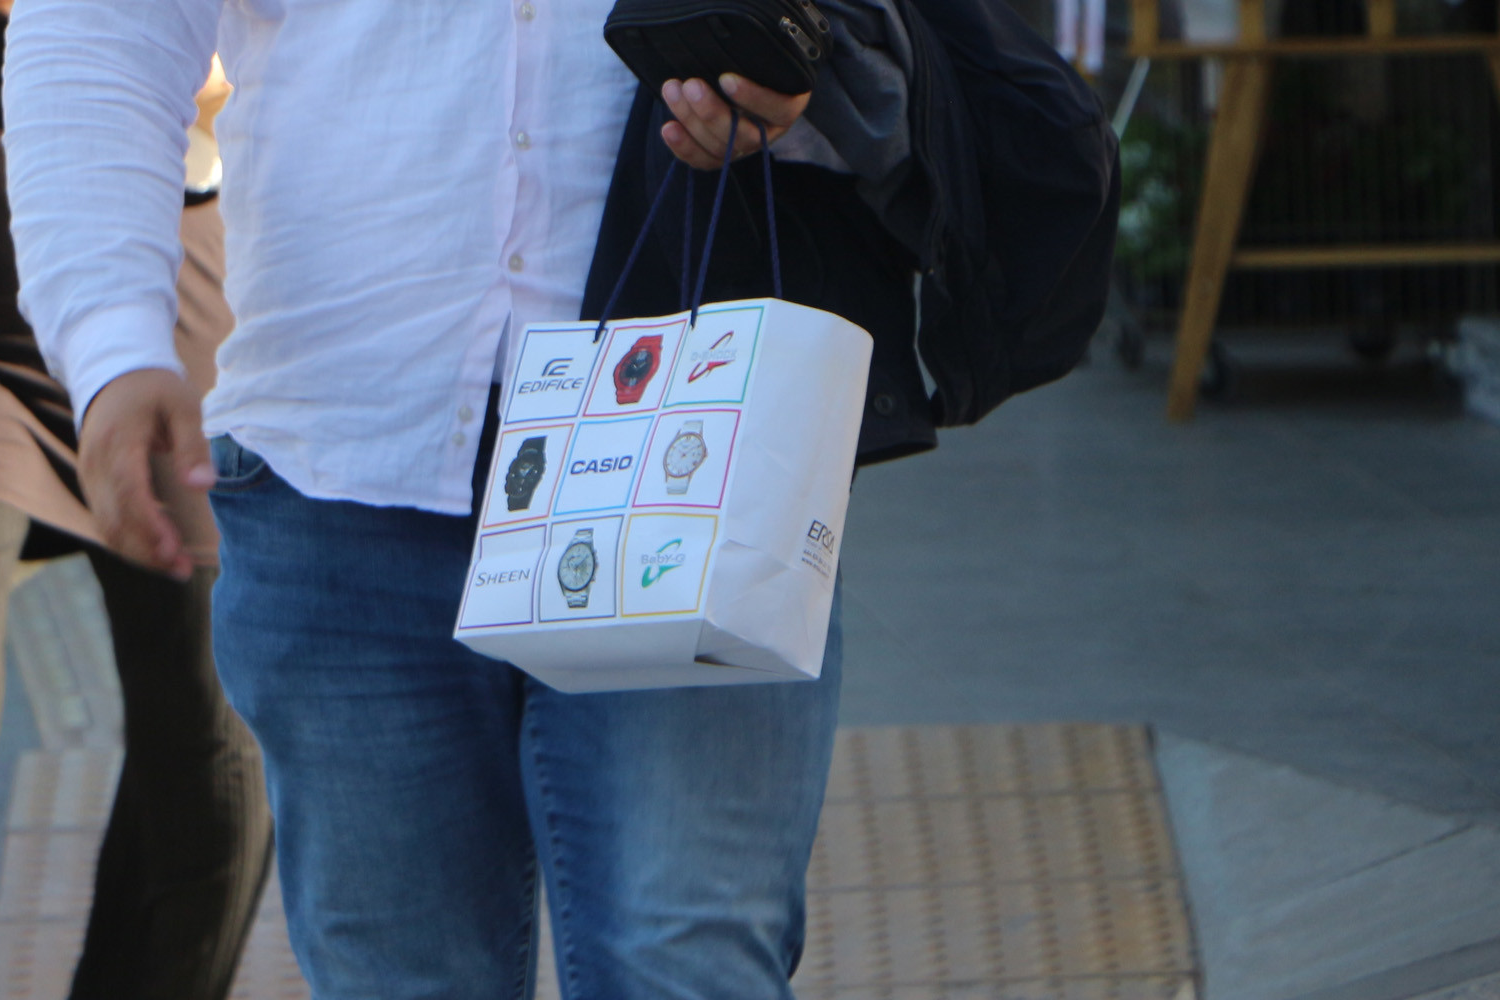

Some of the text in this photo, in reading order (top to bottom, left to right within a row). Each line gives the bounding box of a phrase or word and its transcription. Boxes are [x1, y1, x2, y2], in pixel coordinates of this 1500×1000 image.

[518, 378, 584, 394] EDIFICE
[571, 455, 633, 474] CASIO
[475, 568, 531, 587] SHEEN
